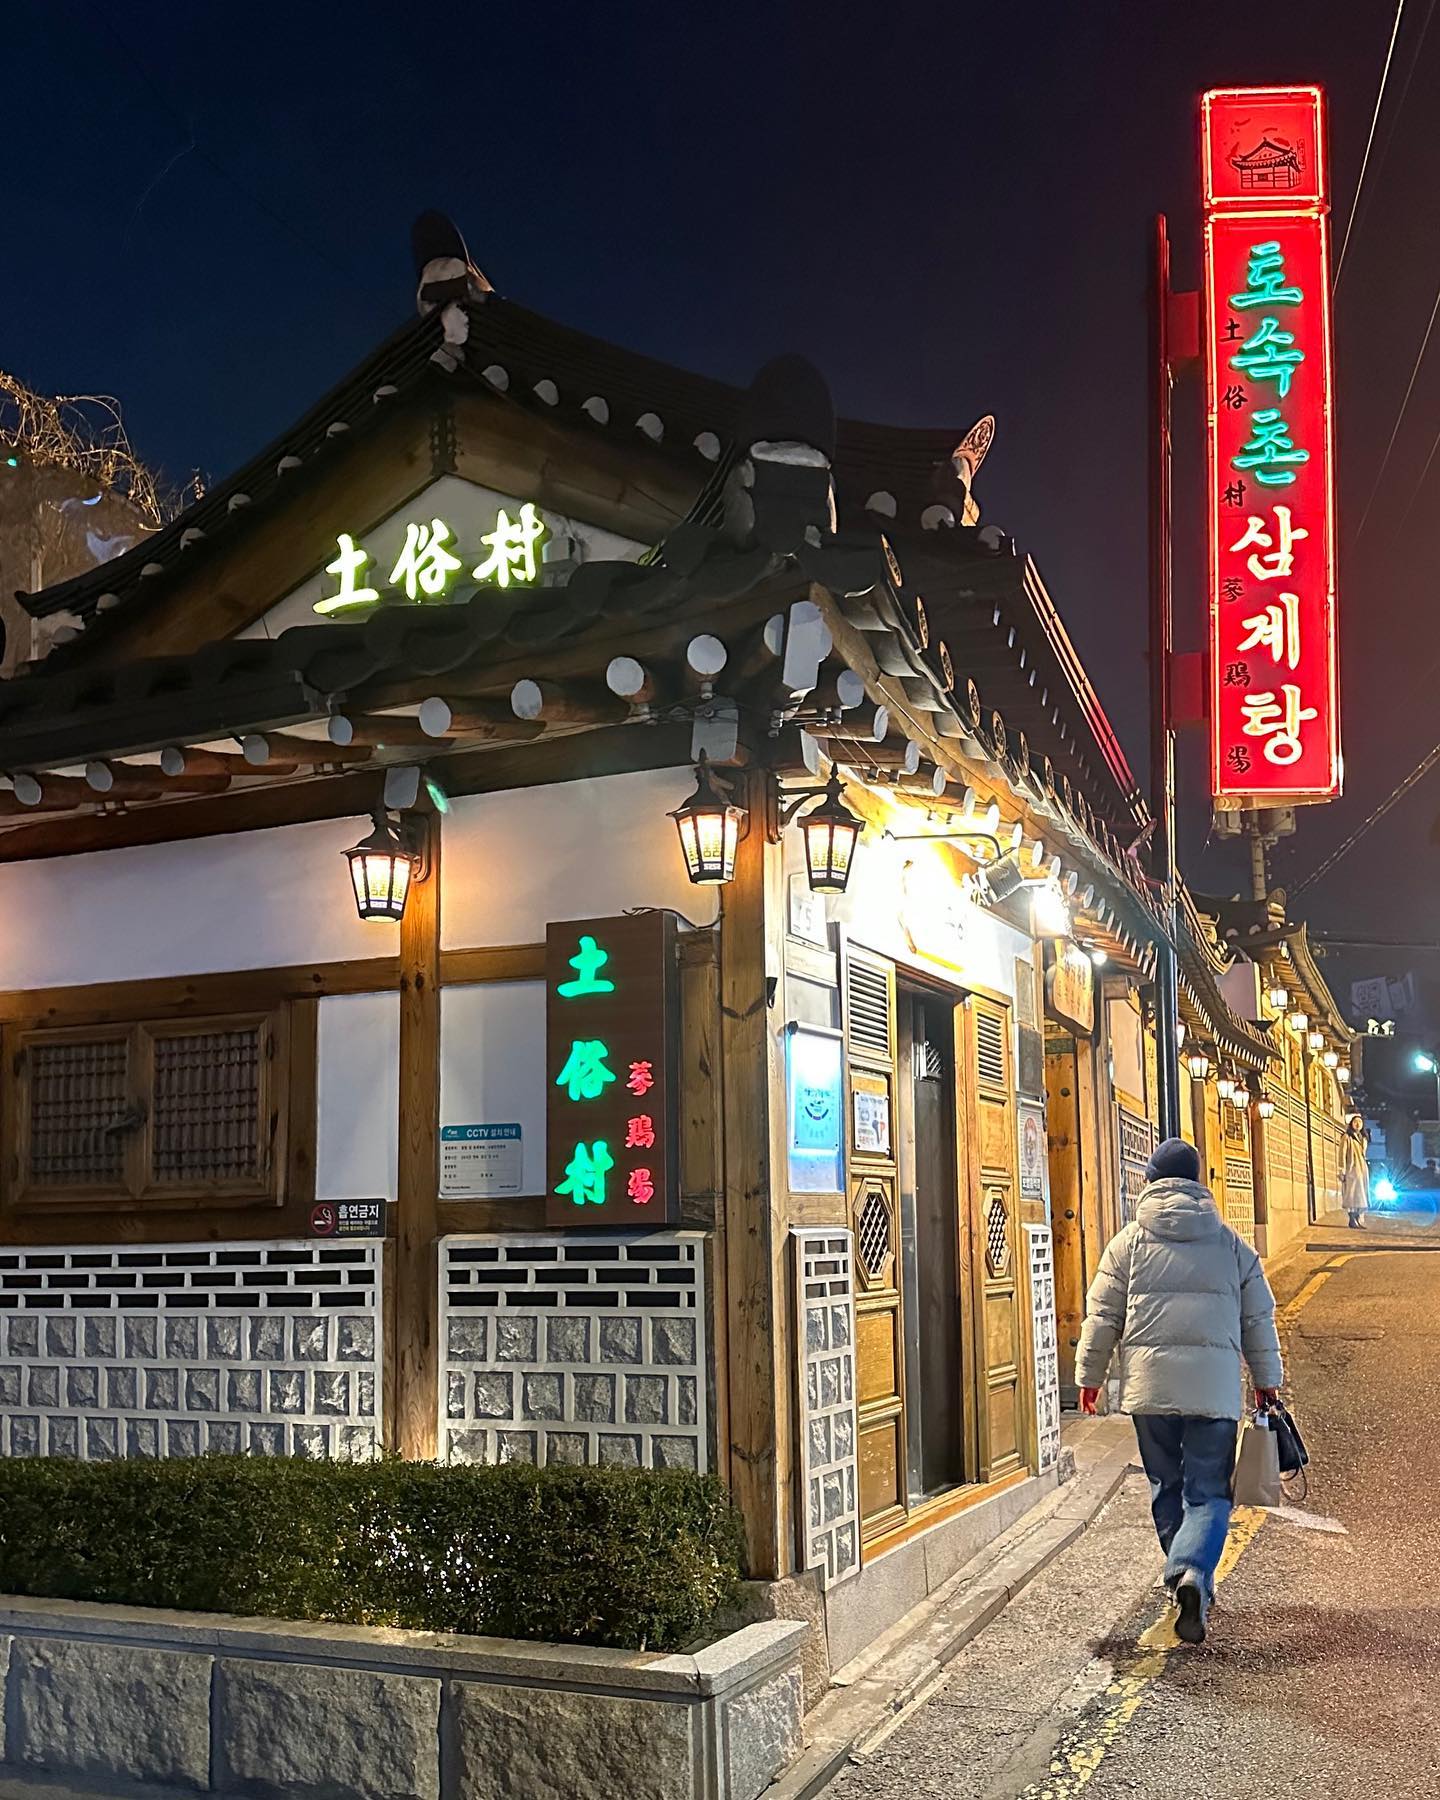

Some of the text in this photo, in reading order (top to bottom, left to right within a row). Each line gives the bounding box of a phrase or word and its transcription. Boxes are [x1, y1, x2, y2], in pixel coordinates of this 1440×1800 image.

[312, 502, 545, 614] 土俗村
[1229, 240, 1318, 766] 토속촌 삼계탕
[554, 935, 617, 1205] 土俗村
[466, 1128, 489, 1138] CCTV
[338, 1203, 379, 1219] 흡연금지
